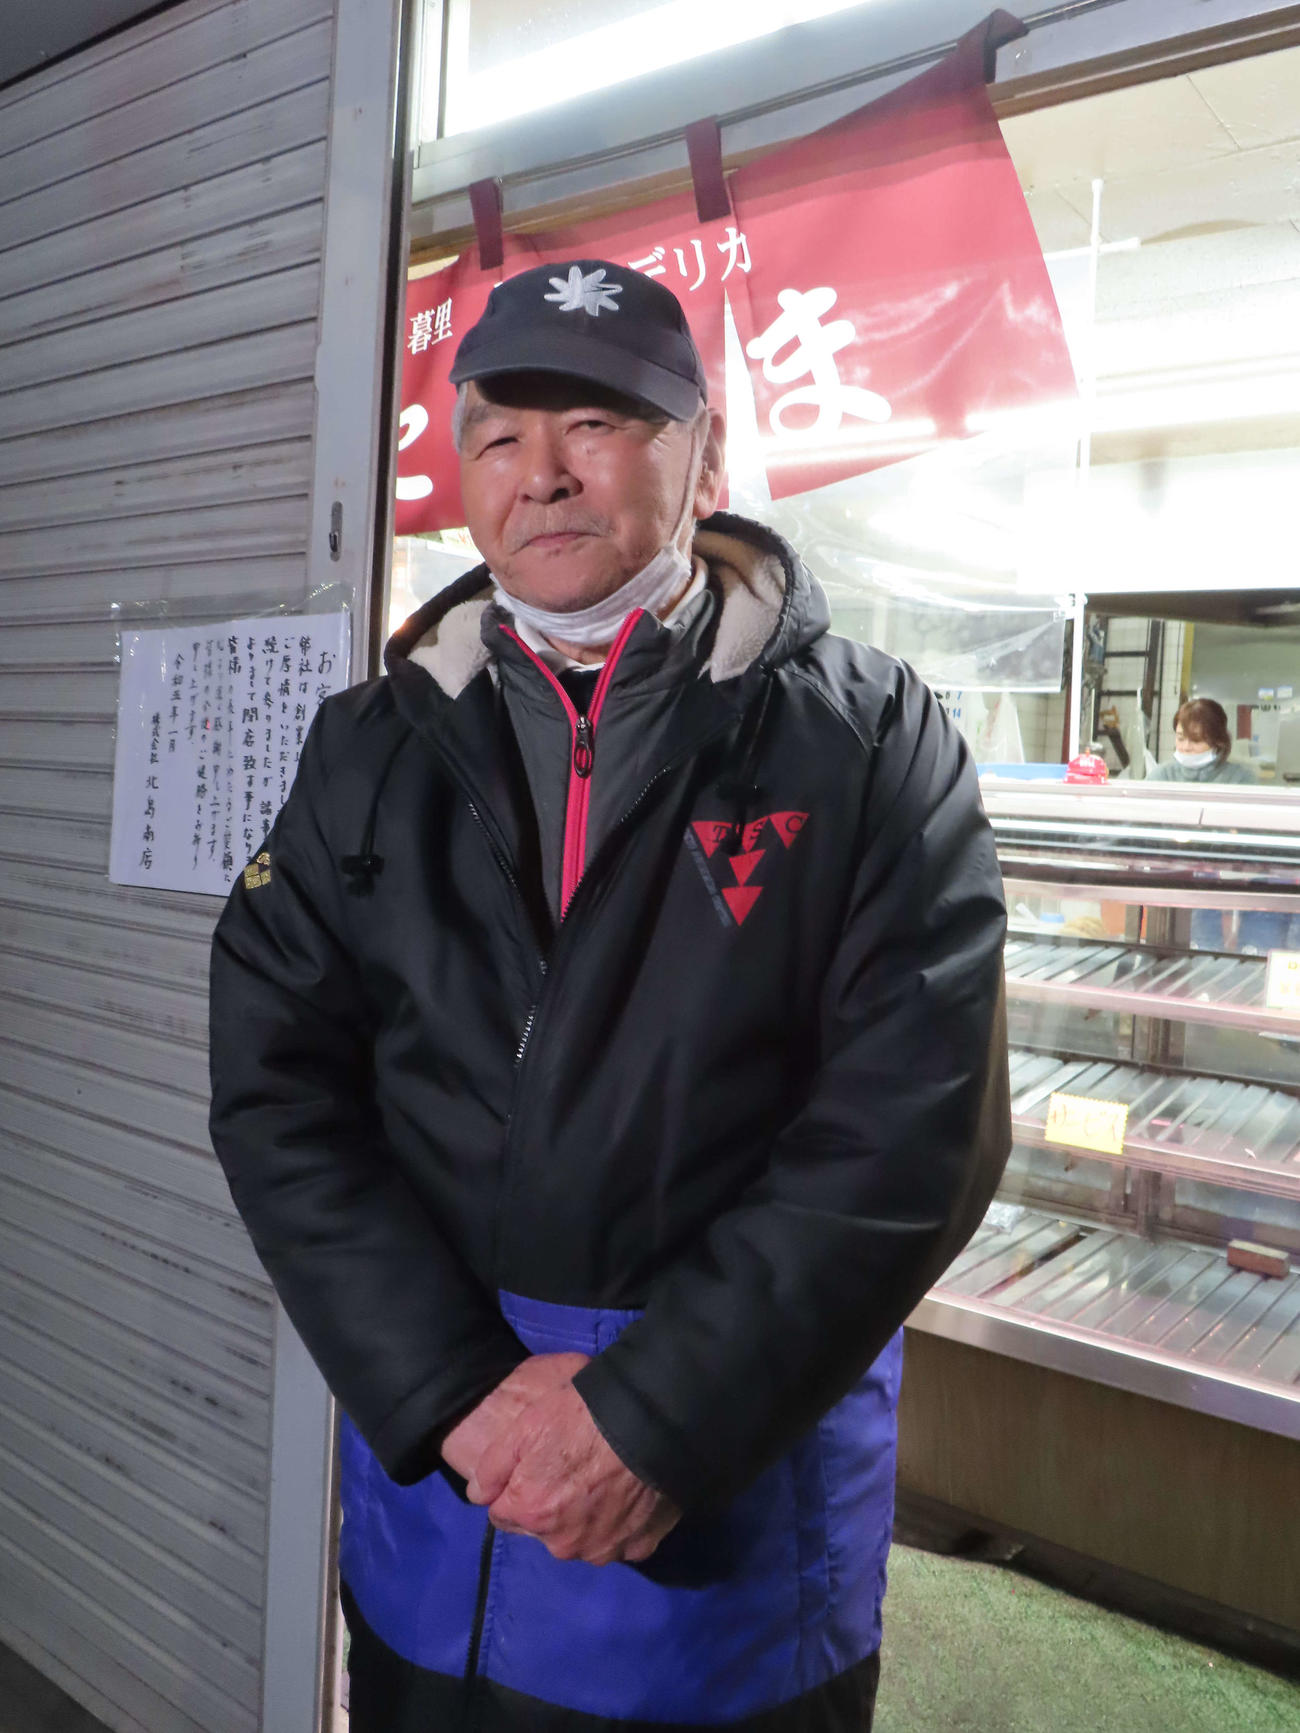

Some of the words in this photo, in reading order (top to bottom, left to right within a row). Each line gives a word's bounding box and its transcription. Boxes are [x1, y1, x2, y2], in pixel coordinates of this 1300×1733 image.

[627, 227, 752, 291] デリカ
[745, 286, 892, 438] ま
